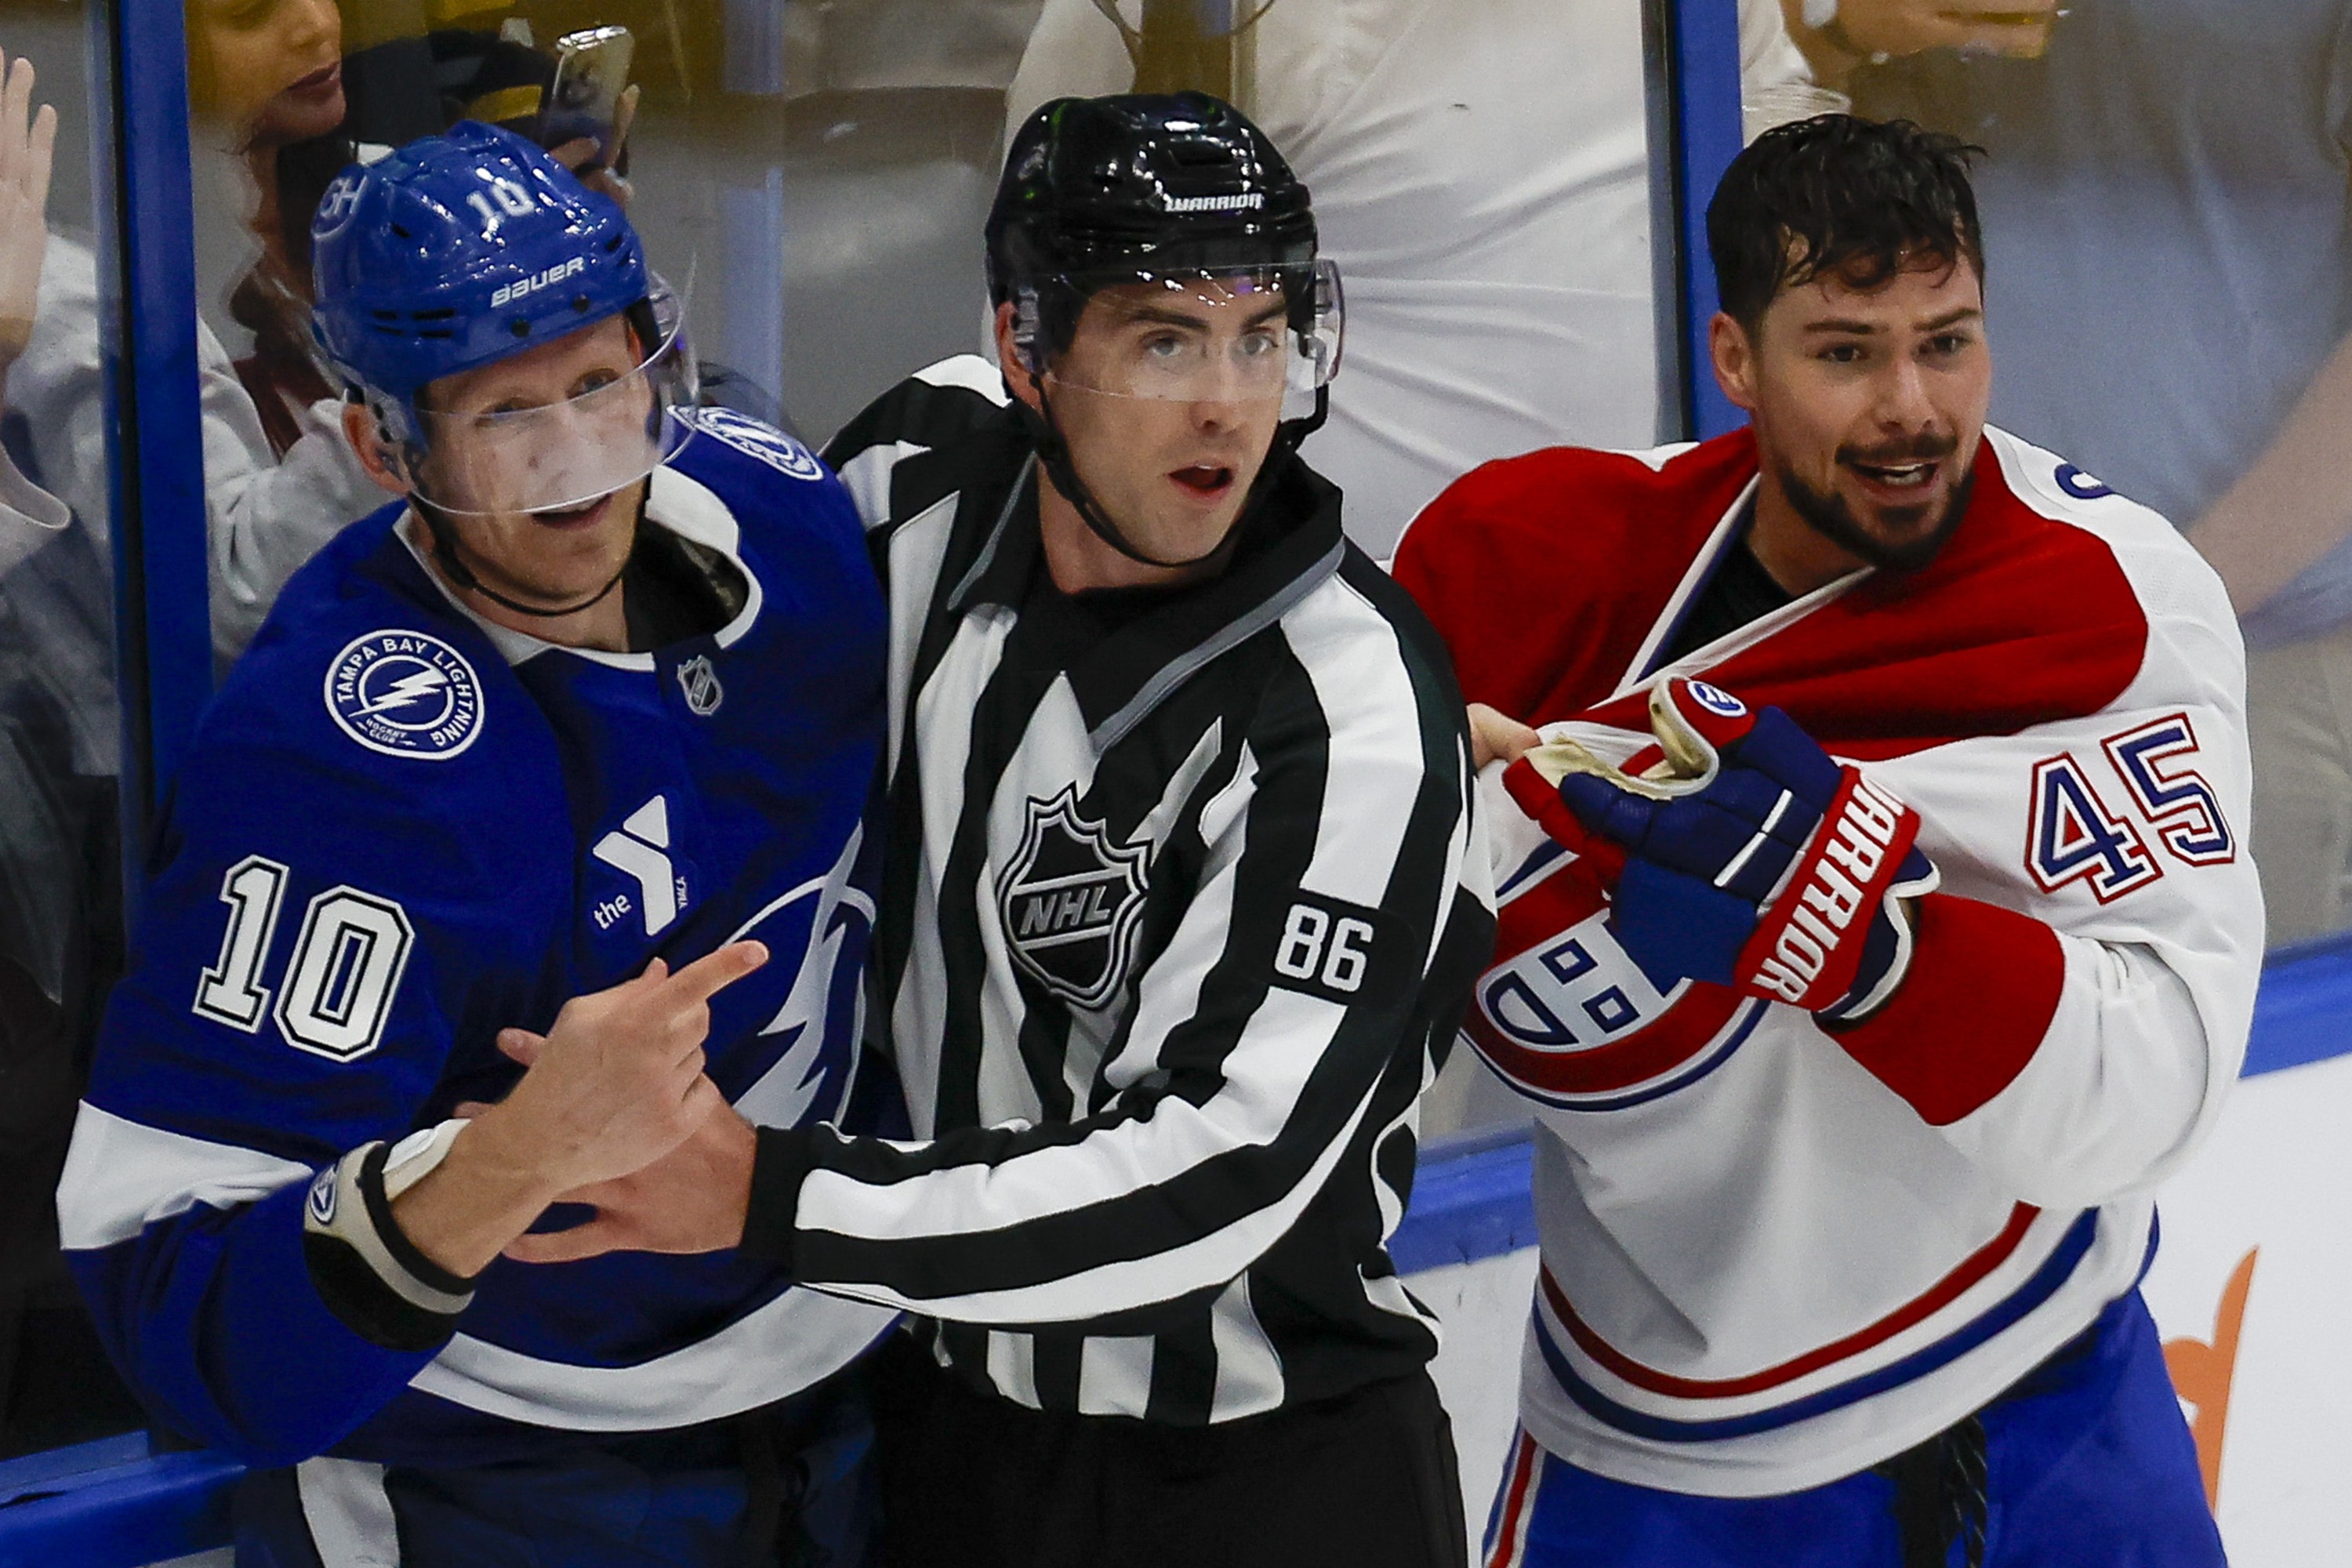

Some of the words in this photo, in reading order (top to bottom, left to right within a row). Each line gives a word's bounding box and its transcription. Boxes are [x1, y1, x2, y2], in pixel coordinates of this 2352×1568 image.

[466, 180, 535, 227] 10
[1164, 193, 1265, 212] WARRIOR
[490, 256, 585, 307] BAUER
[336, 645, 378, 703] TAMPA
[382, 637, 428, 655] BAY
[430, 650, 474, 747] LIGHTNING
[2024, 711, 2236, 906] 45
[593, 894, 632, 929] the
[1020, 885, 1111, 935] NHL
[191, 854, 416, 1062] 10
[1275, 904, 1374, 992] 86
